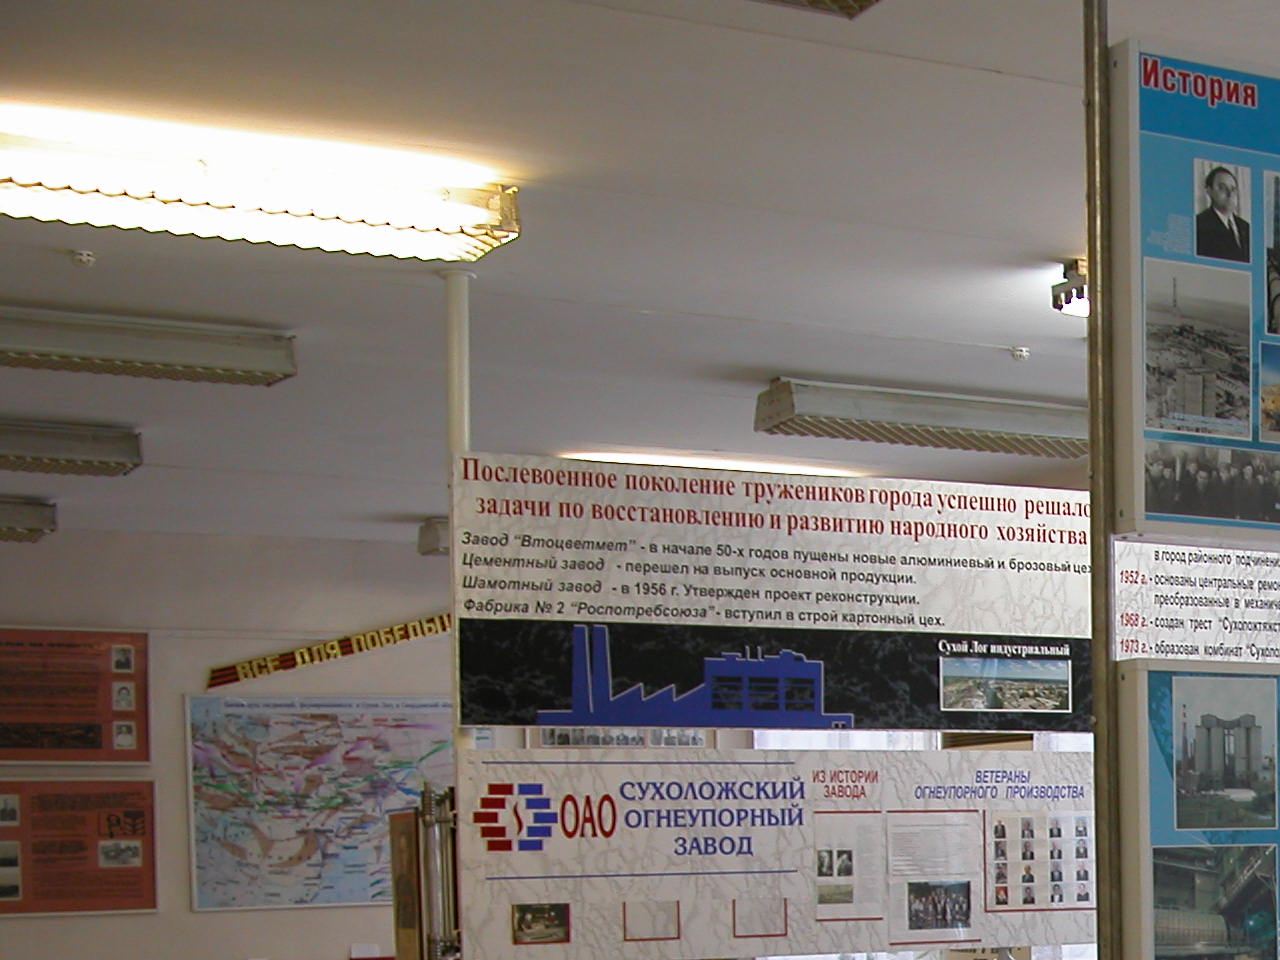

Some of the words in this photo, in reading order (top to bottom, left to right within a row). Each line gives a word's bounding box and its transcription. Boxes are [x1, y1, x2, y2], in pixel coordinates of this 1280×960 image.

[1142, 55, 1258, 107] История
[461, 457, 617, 489] Послевоенное
[625, 472, 736, 497] поколение
[741, 479, 865, 505] тружеников
[869, 487, 932, 513] города
[936, 492, 1017, 515] успешно
[476, 497, 551, 518] задачи
[559, 502, 583, 521] по
[591, 504, 764, 529] восстановлению
[770, 513, 782, 530] и
[786, 515, 884, 536] развитию
[890, 520, 989, 543] народного
[996, 523, 1088, 546] хозяйства
[462, 531, 508, 547] Завод
[649, 543, 657, 552] в
[662, 543, 712, 556] начале
[716, 543, 745, 558] 50-х
[749, 548, 788, 561] годов
[794, 551, 849, 566] пущены
[853, 553, 896, 565] новые
[900, 555, 995, 569] алюминиевый
[998, 560, 1006, 570] и
[1009, 558, 1071, 573] брозовый
[1161, 551, 1186, 564] город
[1188, 549, 1231, 565] районного
[462, 552, 556, 570] Цементный
[561, 557, 604, 571] завод
[625, 562, 688, 577] перешел
[693, 566, 708, 577] на
[714, 566, 766, 582] выпуск
[771, 566, 837, 581] основной
[840, 570, 917, 587] продукции.
[462, 574, 552, 593] Шамотный
[558, 579, 602, 594] завод
[621, 584, 630, 595] в
[634, 582, 667, 597] 1956
[671, 586, 680, 597] г.
[683, 584, 761, 603] Утвержден
[764, 590, 811, 604] проект
[815, 590, 920, 607] реконструкции.
[1119, 570, 1139, 584] 1952
[1154, 574, 1197, 587] основаны
[1199, 577, 1254, 591] центральные
[1154, 592, 1230, 608] преобразованные
[463, 598, 529, 616] Фабрика
[535, 601, 552, 614] №
[556, 601, 565, 615] 2
[725, 608, 782, 623] вступил
[786, 611, 794, 621] в
[798, 609, 838, 625] строй
[841, 611, 915, 628] картонный
[918, 615, 945, 629] цех.
[1119, 613, 1139, 627] 1968
[1154, 616, 1185, 629] создан
[1190, 619, 1212, 632] трест
[938, 639, 969, 655] Сухой
[970, 640, 989, 654] Лог
[990, 641, 1070, 658] индустриальный
[1119, 639, 1139, 653] 1973
[1154, 640, 1199, 656] образован
[1204, 642, 1243, 657] комбинат
[237, 657, 281, 679] ВСЕ
[294, 640, 342, 668] ДЛЯ
[812, 771, 826, 784] ИЗ
[829, 770, 879, 784] ИСТОРИИ
[975, 770, 1031, 784] ВЕТЕРАНЫ
[823, 785, 867, 799] ЗАВОДА
[914, 785, 998, 800] ОГНЕУПОРНОГО
[1005, 785, 1085, 800] ПРОИЗВОДСТВА
[560, 794, 617, 839] ОАО
[619, 777, 806, 801] СУХОЛОЖСКИЙ
[624, 803, 804, 829] ОГНЕУПОРНЫЙ
[673, 836, 754, 856] ЗАВОД
